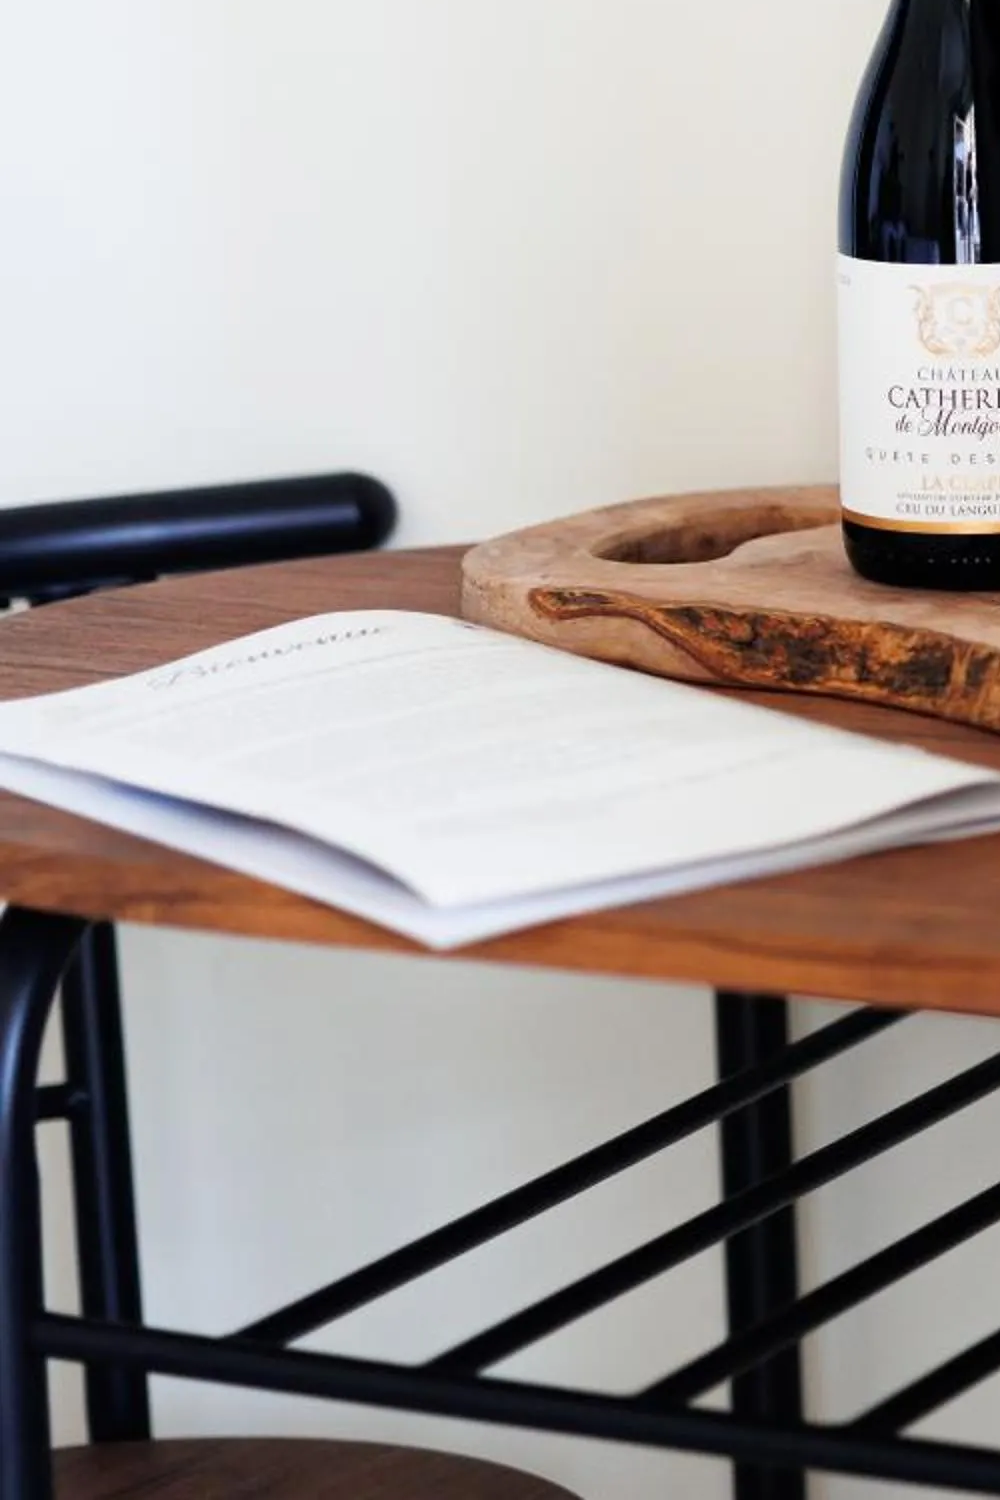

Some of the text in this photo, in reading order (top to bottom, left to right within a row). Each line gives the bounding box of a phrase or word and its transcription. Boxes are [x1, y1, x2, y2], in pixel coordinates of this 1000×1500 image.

[895, 414, 912, 433] de
[951, 452, 996, 465] DES
[925, 503, 945, 515] DU
